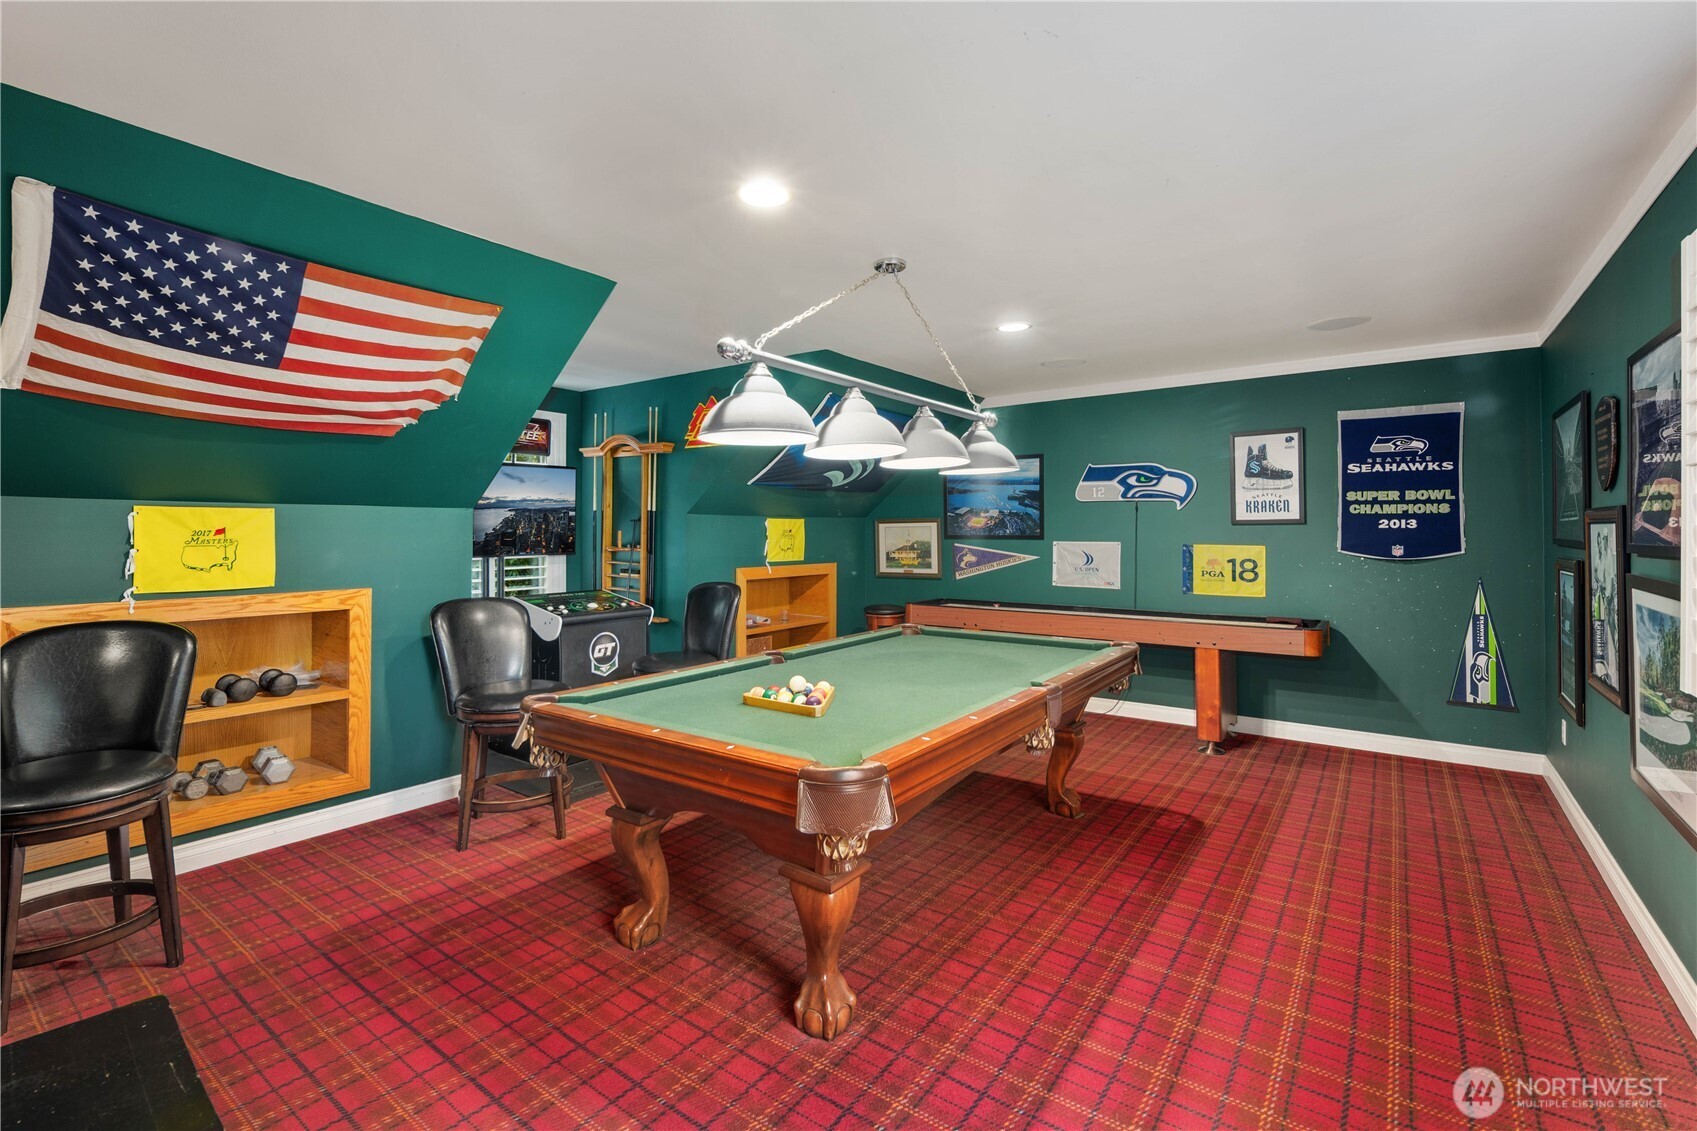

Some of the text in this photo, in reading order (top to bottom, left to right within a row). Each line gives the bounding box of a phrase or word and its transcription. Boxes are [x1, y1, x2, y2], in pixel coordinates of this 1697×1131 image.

[1366, 455, 1433, 463] SEATTLE
[1346, 461, 1455, 474] SEAHAWKS
[1092, 486, 1105, 498] 12
[1345, 489, 1456, 501] SUPER BOWL
[1245, 499, 1290, 514] KRAKEN
[1349, 502, 1451, 515] CHAMPIONS
[1378, 518, 1418, 529] 2013
[191, 529, 213, 537] 2017
[184, 537, 234, 545] MASTERS
[957, 556, 1022, 577] WASHINGTON HUSKIES
[1226, 558, 1260, 583] 18
[1201, 570, 1226, 578] PGA
[593, 642, 616, 658] GT
